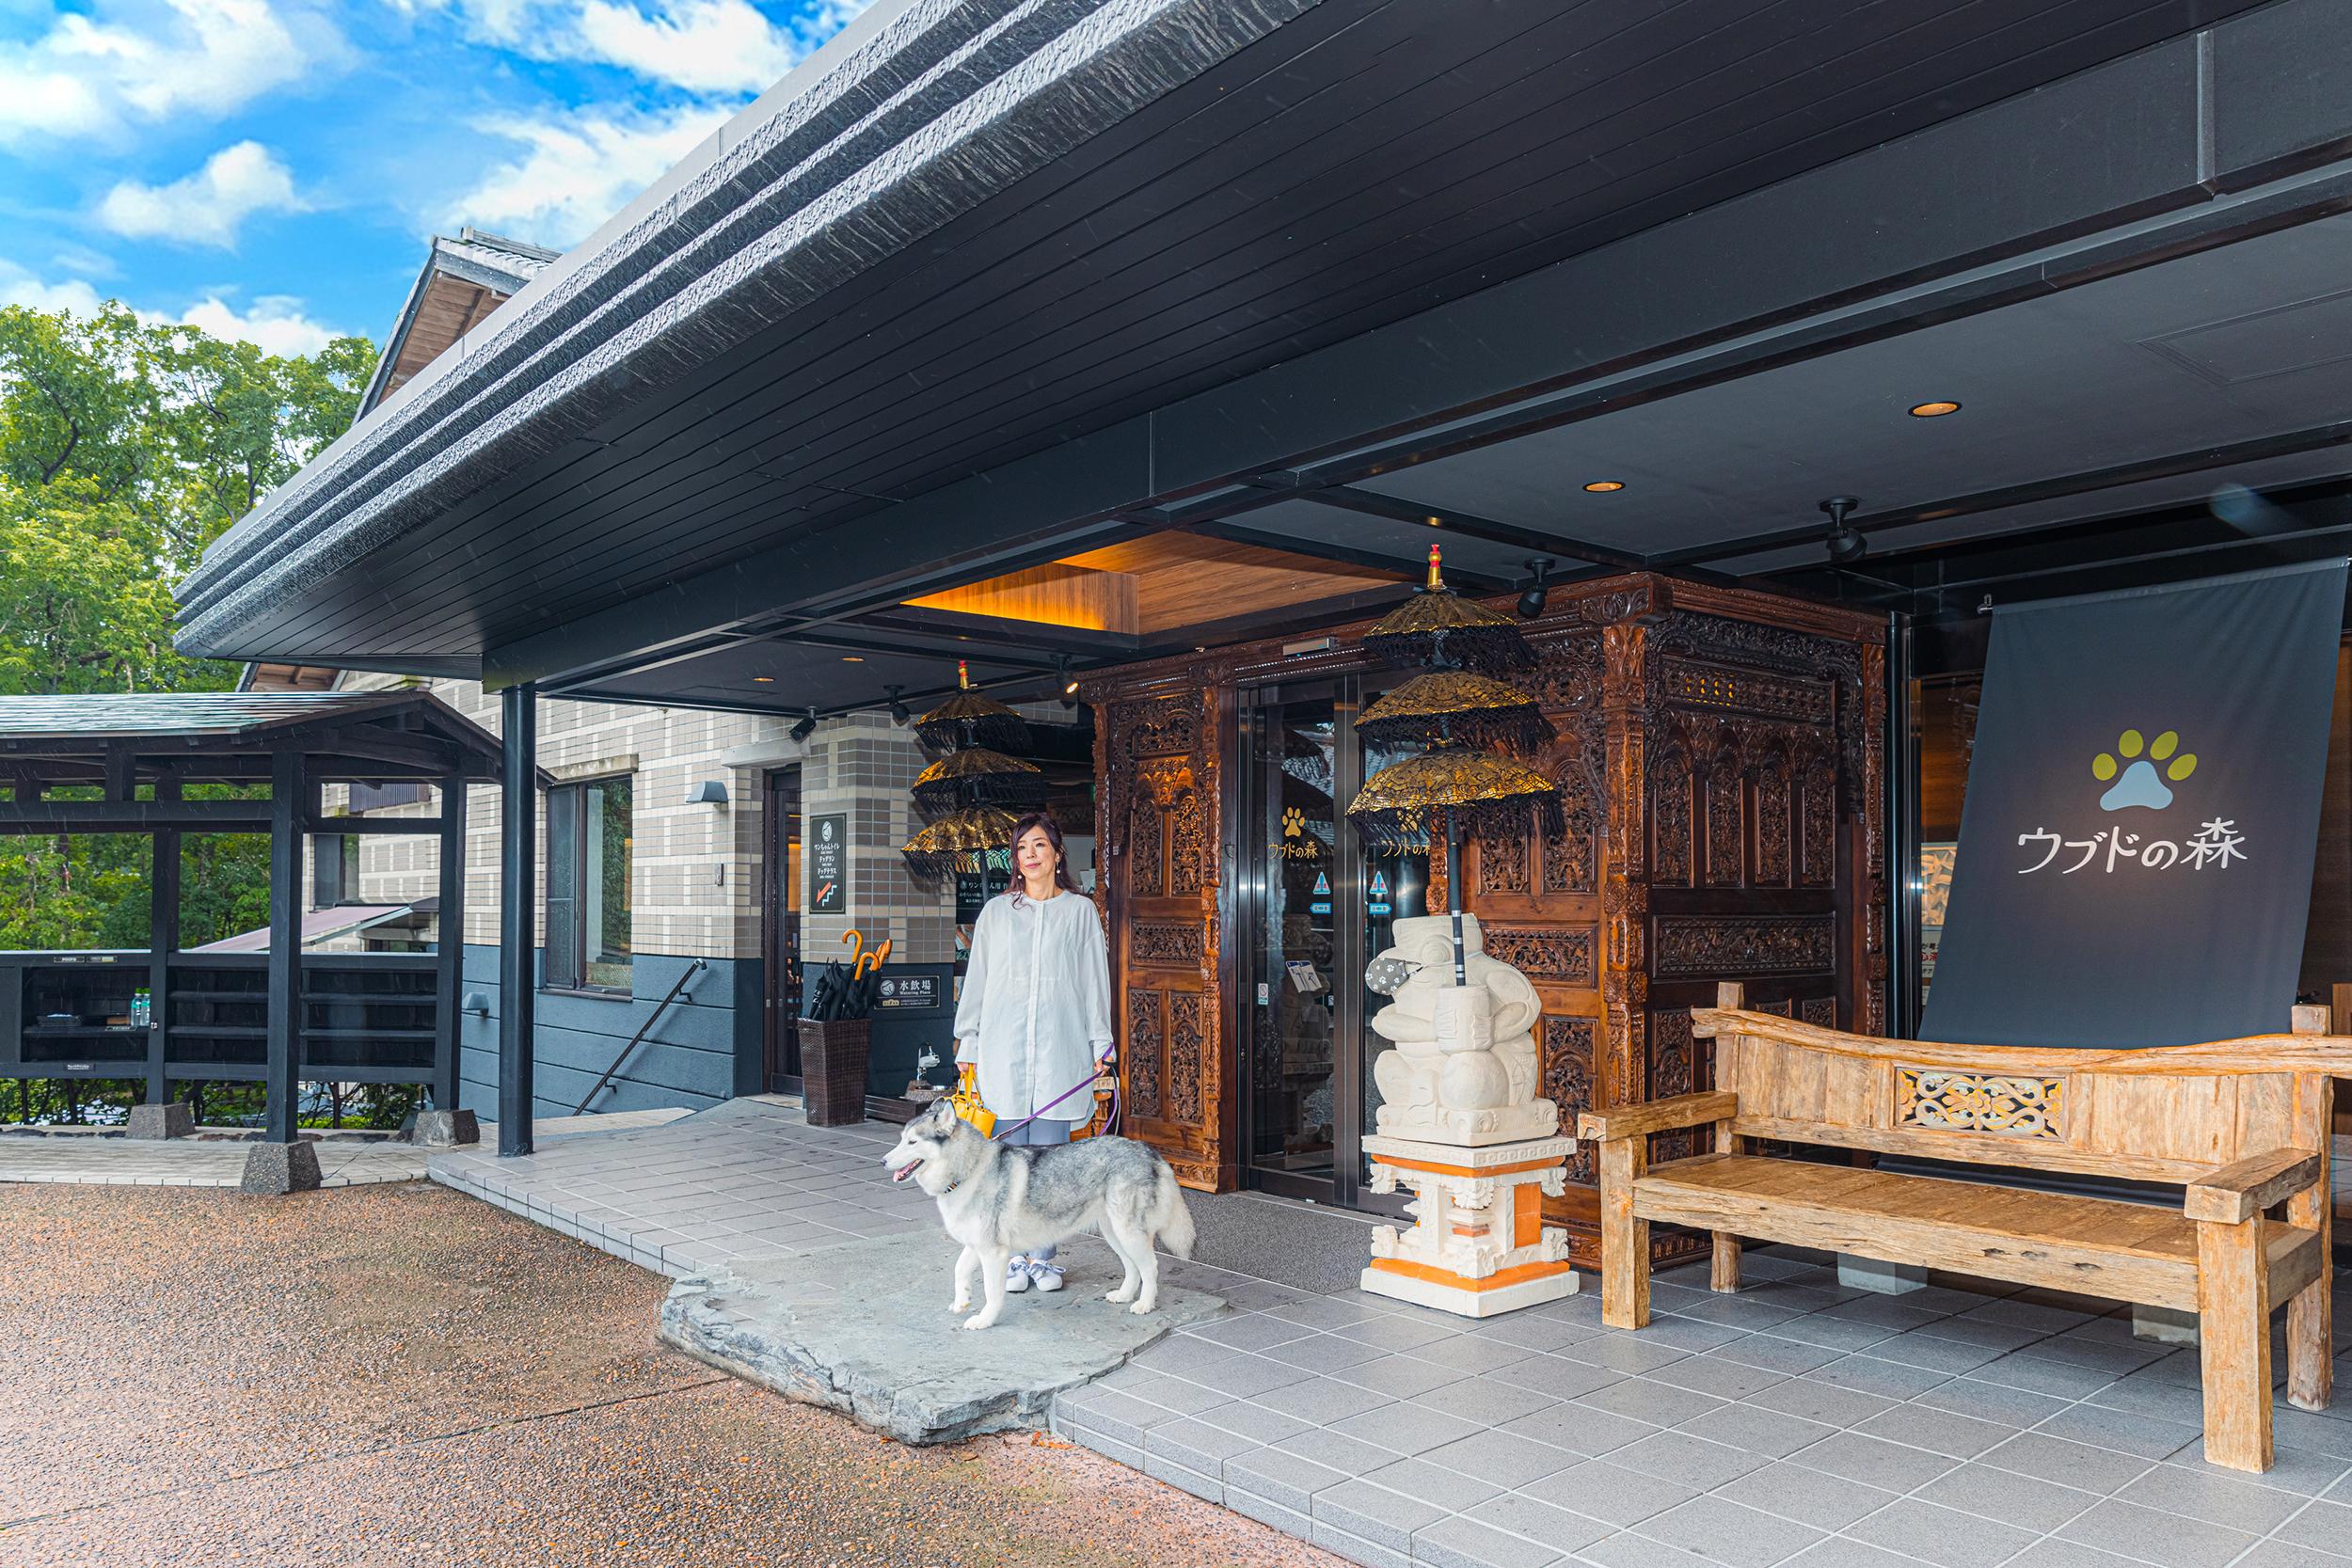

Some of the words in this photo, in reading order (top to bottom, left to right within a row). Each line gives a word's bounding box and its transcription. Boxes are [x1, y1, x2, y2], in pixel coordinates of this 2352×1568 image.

[1268, 840, 1318, 859] ウブドの森
[2017, 816, 2248, 874] ウブドの森
[900, 979, 931, 991] 水飲場
